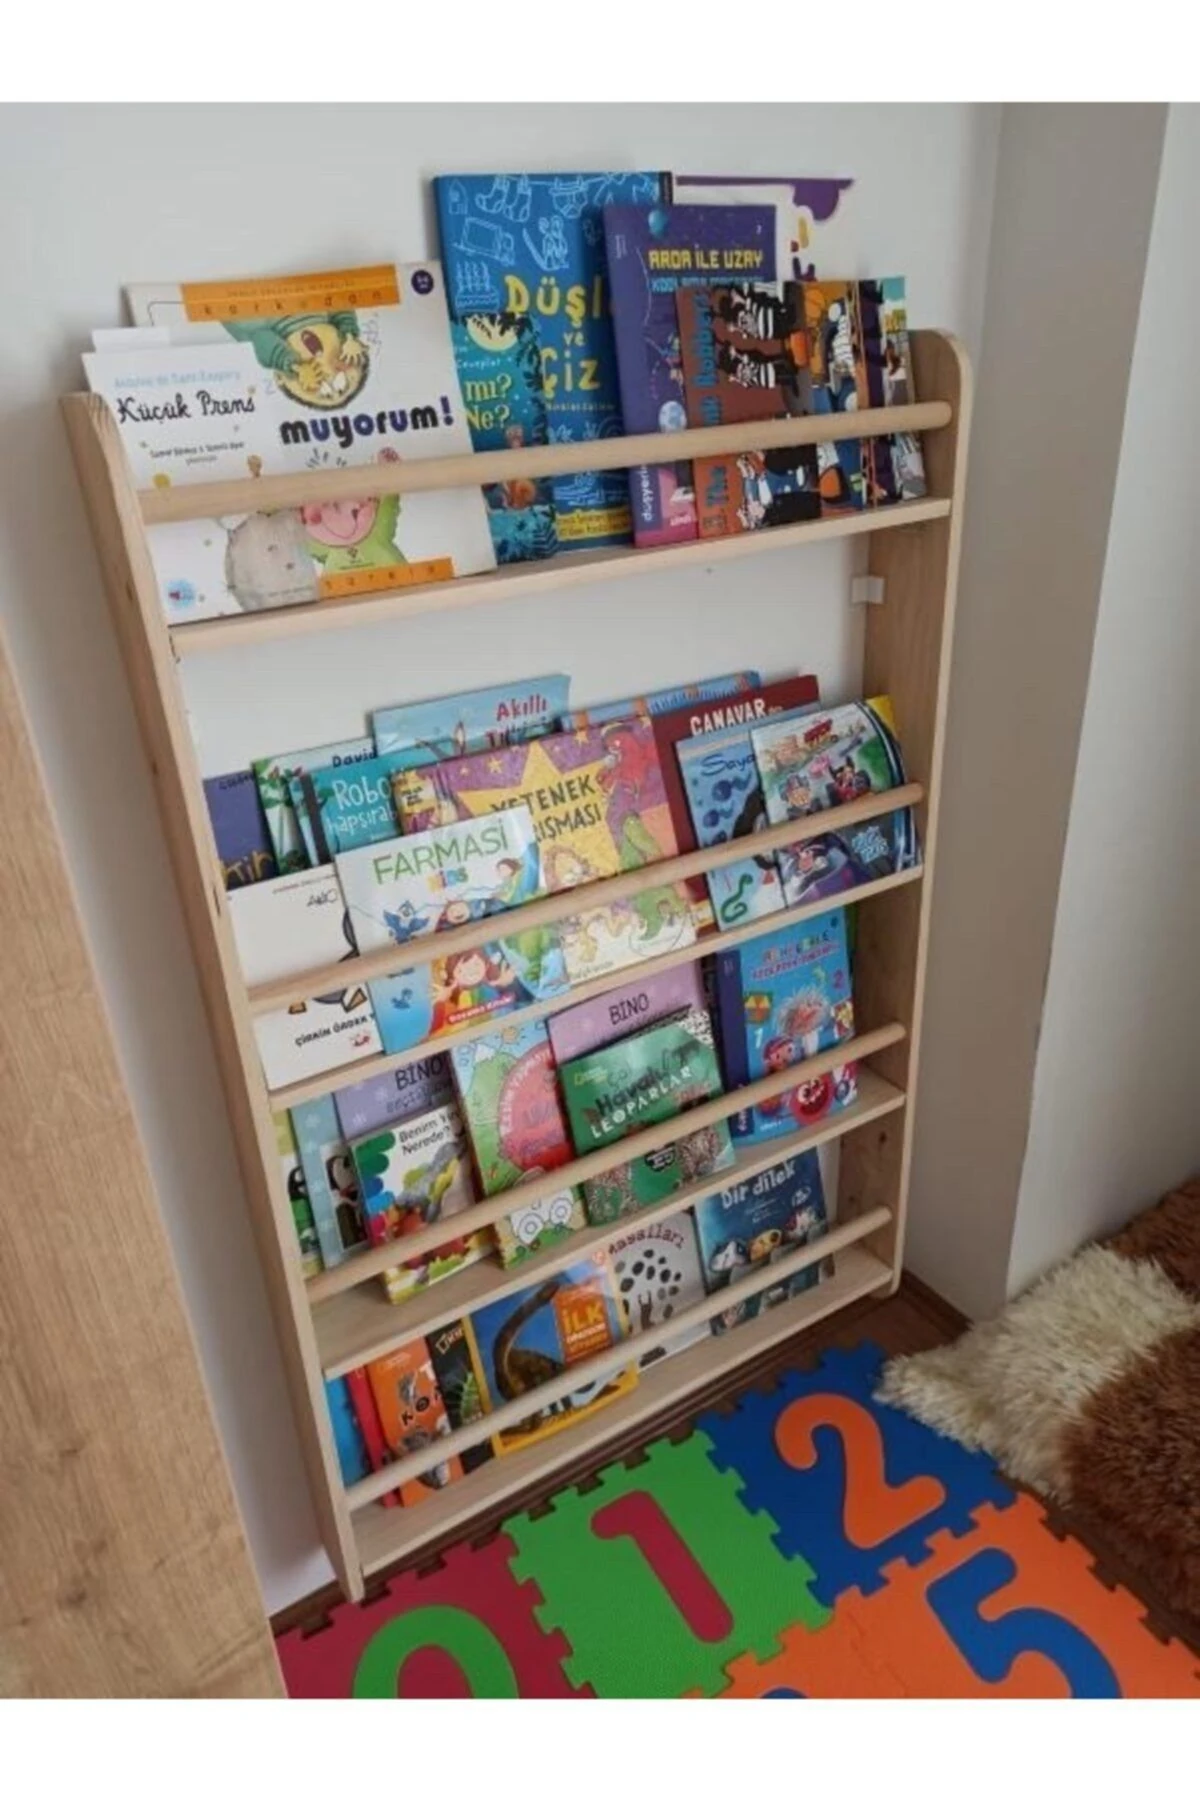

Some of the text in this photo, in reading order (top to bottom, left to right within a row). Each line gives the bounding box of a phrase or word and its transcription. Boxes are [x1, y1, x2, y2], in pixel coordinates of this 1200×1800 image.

[650, 249, 692, 270] ARDA
[723, 249, 764, 270] UZAY
[563, 331, 587, 347] ve
[115, 389, 255, 424] Küçük Prens
[279, 396, 454, 449] muyorum!
[466, 404, 511, 431] Ne?
[496, 693, 547, 721] Akıllı
[690, 698, 766, 736] CANAVAR
[331, 741, 378, 768] David
[332, 775, 393, 811] Robo
[591, 1065, 693, 1140] LEOPARLAR
[774, 1392, 947, 1549] 2
[589, 1489, 734, 1643] 1
[925, 1546, 1122, 1699] 5
